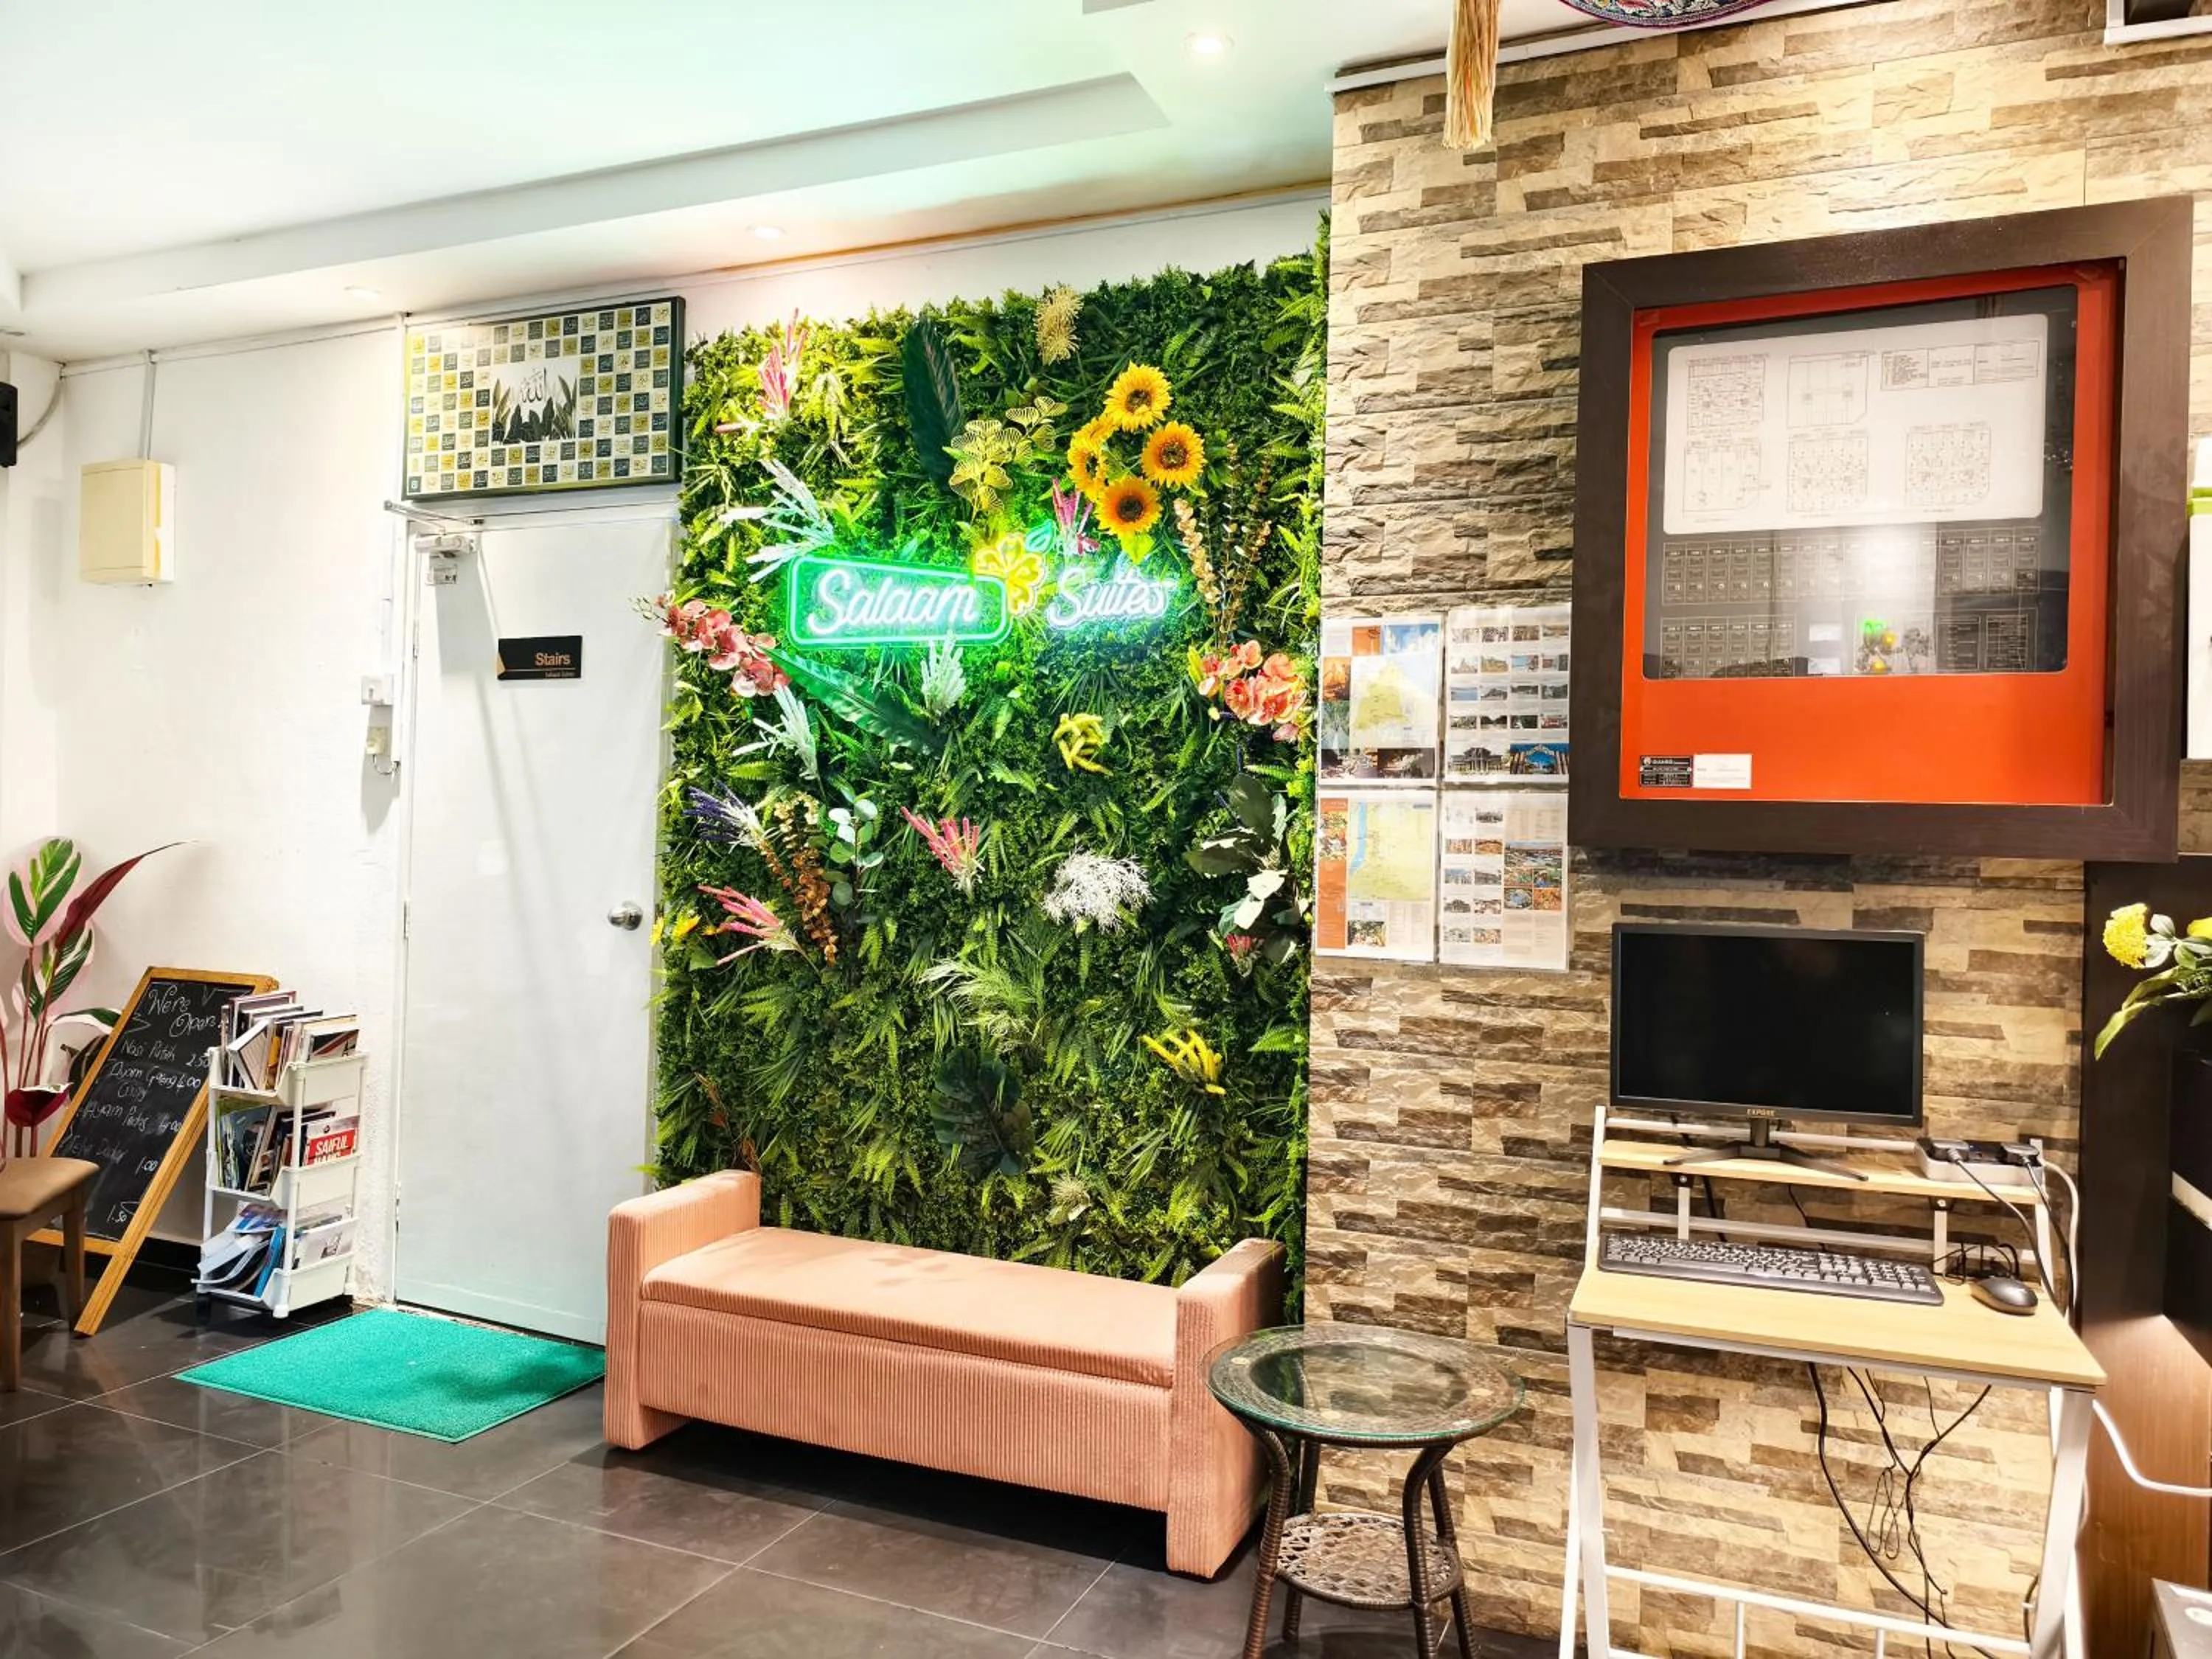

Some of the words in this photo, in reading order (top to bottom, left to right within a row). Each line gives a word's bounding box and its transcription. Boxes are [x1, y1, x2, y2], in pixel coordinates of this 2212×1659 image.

[807, 567, 978, 636] Salaam
[1046, 566, 1178, 630] Suites
[535, 652, 571, 667] Stairs
[314, 1135, 349, 1156] SAIFUL
